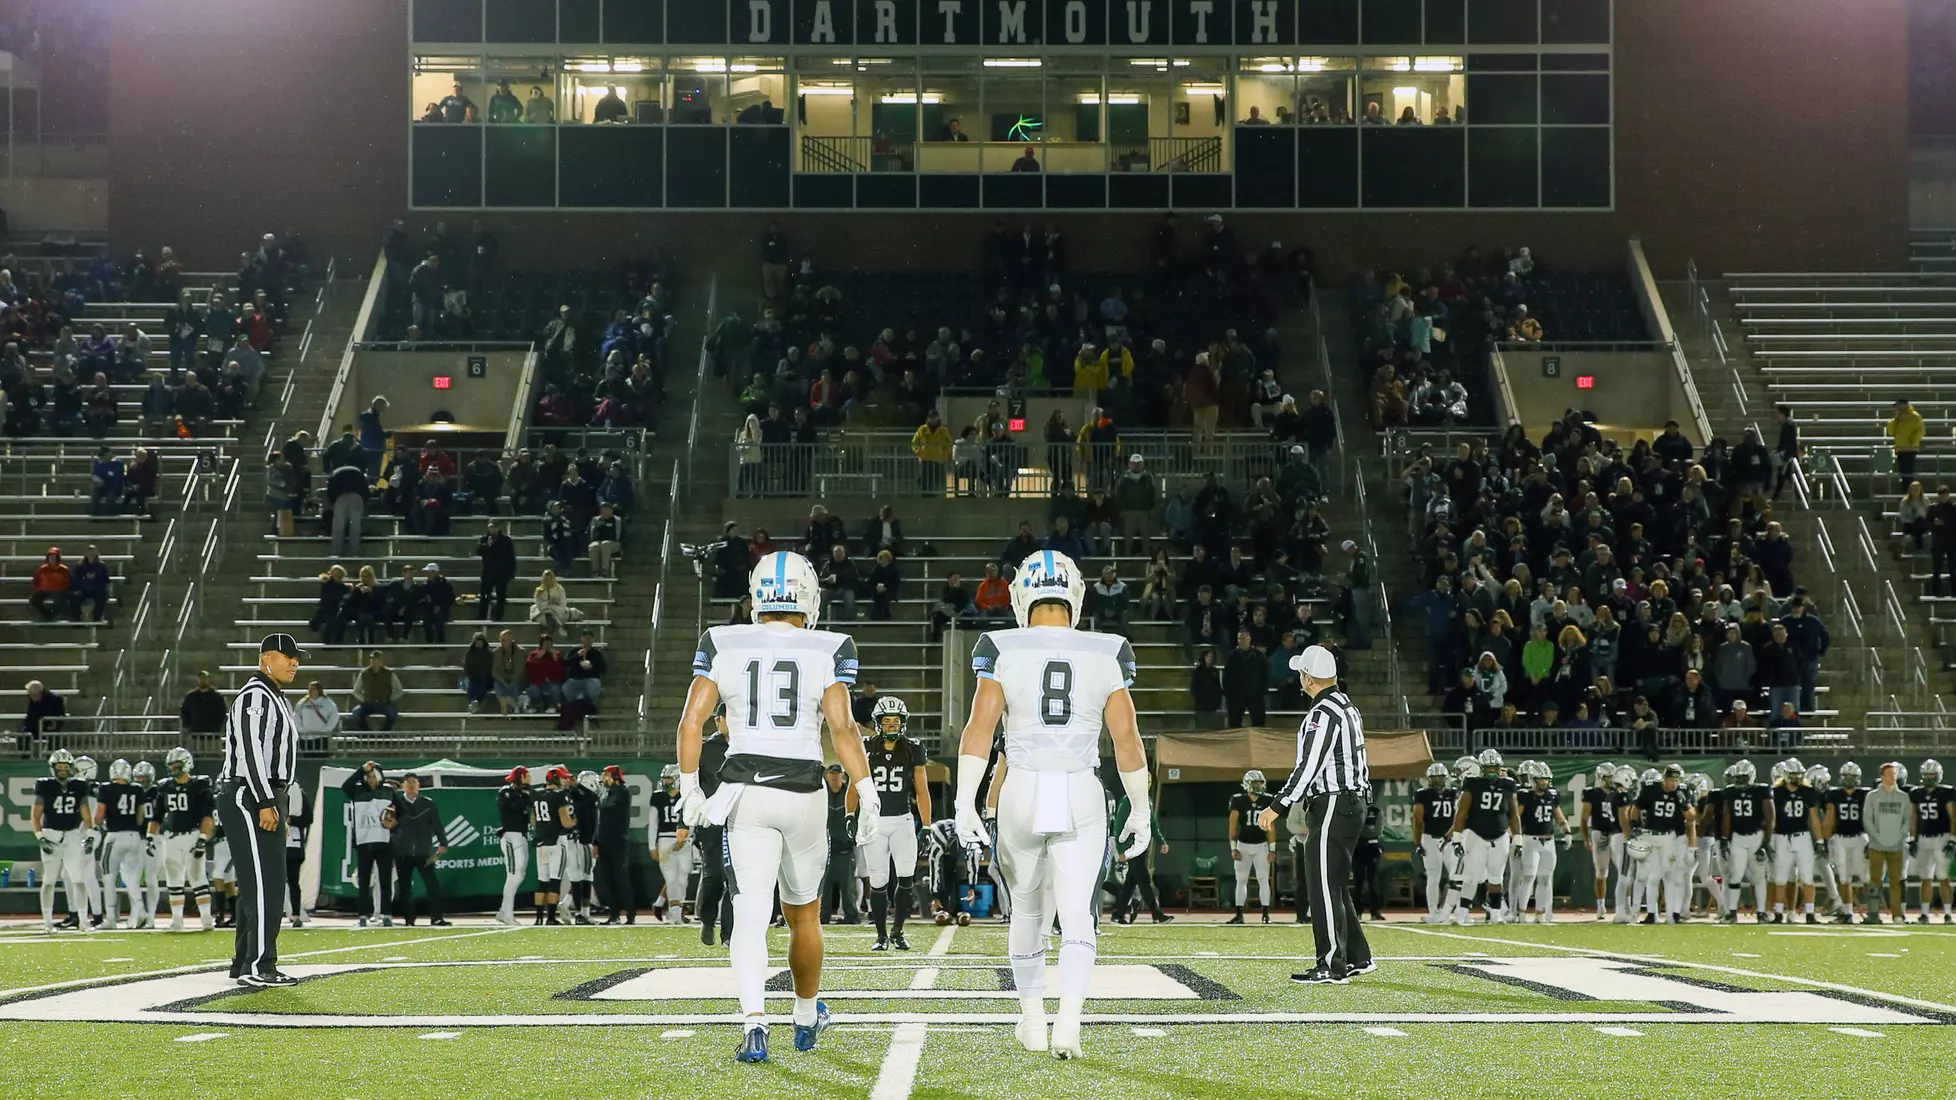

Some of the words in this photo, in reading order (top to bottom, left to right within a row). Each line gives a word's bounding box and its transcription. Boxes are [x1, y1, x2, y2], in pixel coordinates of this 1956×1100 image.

[749, 0, 1279, 43] DARTMOUTH
[472, 363, 481, 374] 6
[1547, 363, 1556, 374] 8
[435, 377, 450, 388] EXIT
[1578, 377, 1593, 388] EXIT
[1013, 404, 1021, 415] 7
[1011, 419, 1024, 430] EXIT
[626, 436, 635, 448] 6
[1398, 436, 1406, 447] 8
[742, 657, 802, 729] 13
[1038, 658, 1075, 728] 8
[889, 700, 896, 709] D
[873, 766, 904, 792] 25
[53, 796, 76, 814] 42
[118, 794, 136, 815] 41
[167, 793, 188, 811] 50
[1432, 801, 1452, 817] 70
[1480, 792, 1503, 811] 97
[1655, 801, 1675, 817] 59
[1734, 800, 1753, 816] 93
[1784, 801, 1803, 817] 48
[534, 801, 551, 821] 18
[1534, 805, 1552, 822] 45
[1839, 803, 1859, 820] 56
[1920, 803, 1939, 820] 55
[435, 859, 475, 869] SPORTS
[477, 856, 506, 867] MEDI
